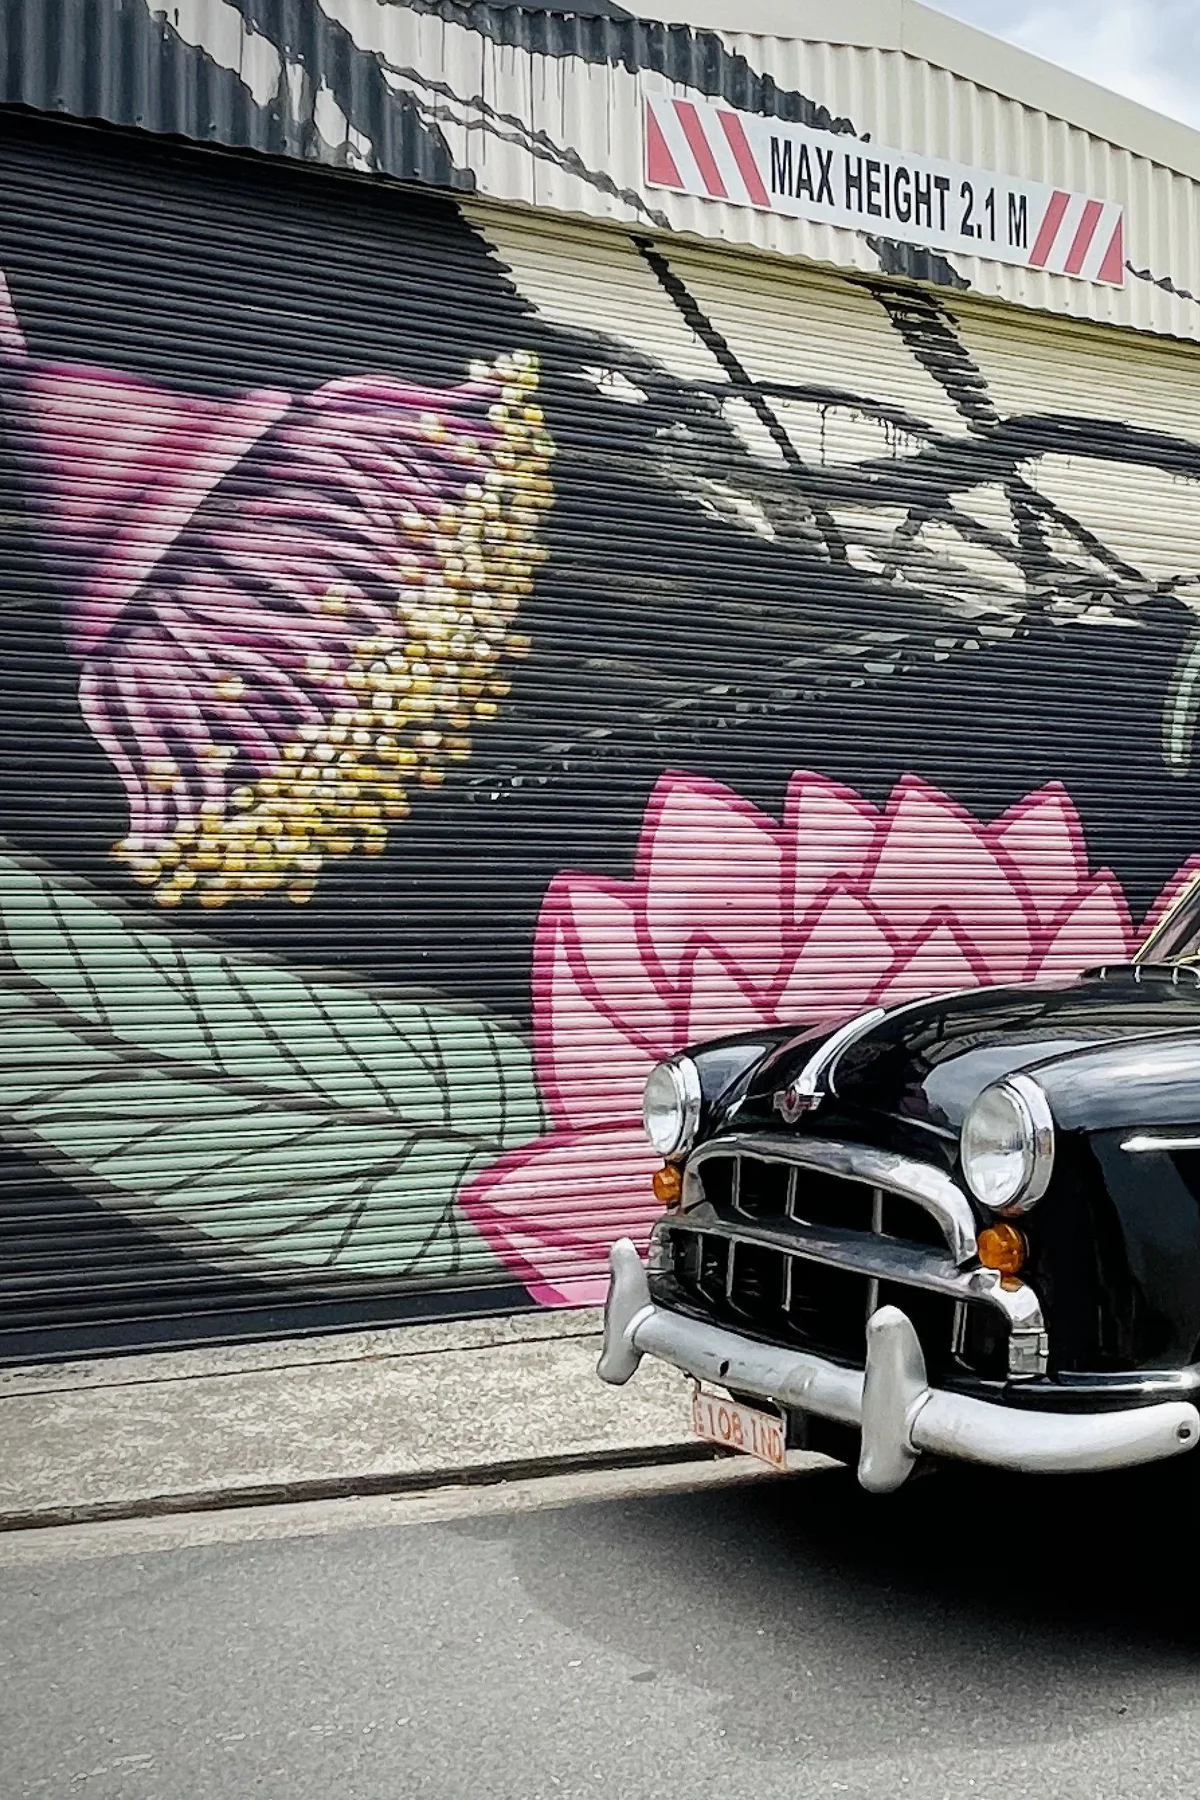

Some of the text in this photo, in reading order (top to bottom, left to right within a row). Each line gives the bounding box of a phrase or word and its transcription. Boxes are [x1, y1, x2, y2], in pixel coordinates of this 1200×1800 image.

[770, 135, 1028, 249] MAX HEIGHT 2.1 M
